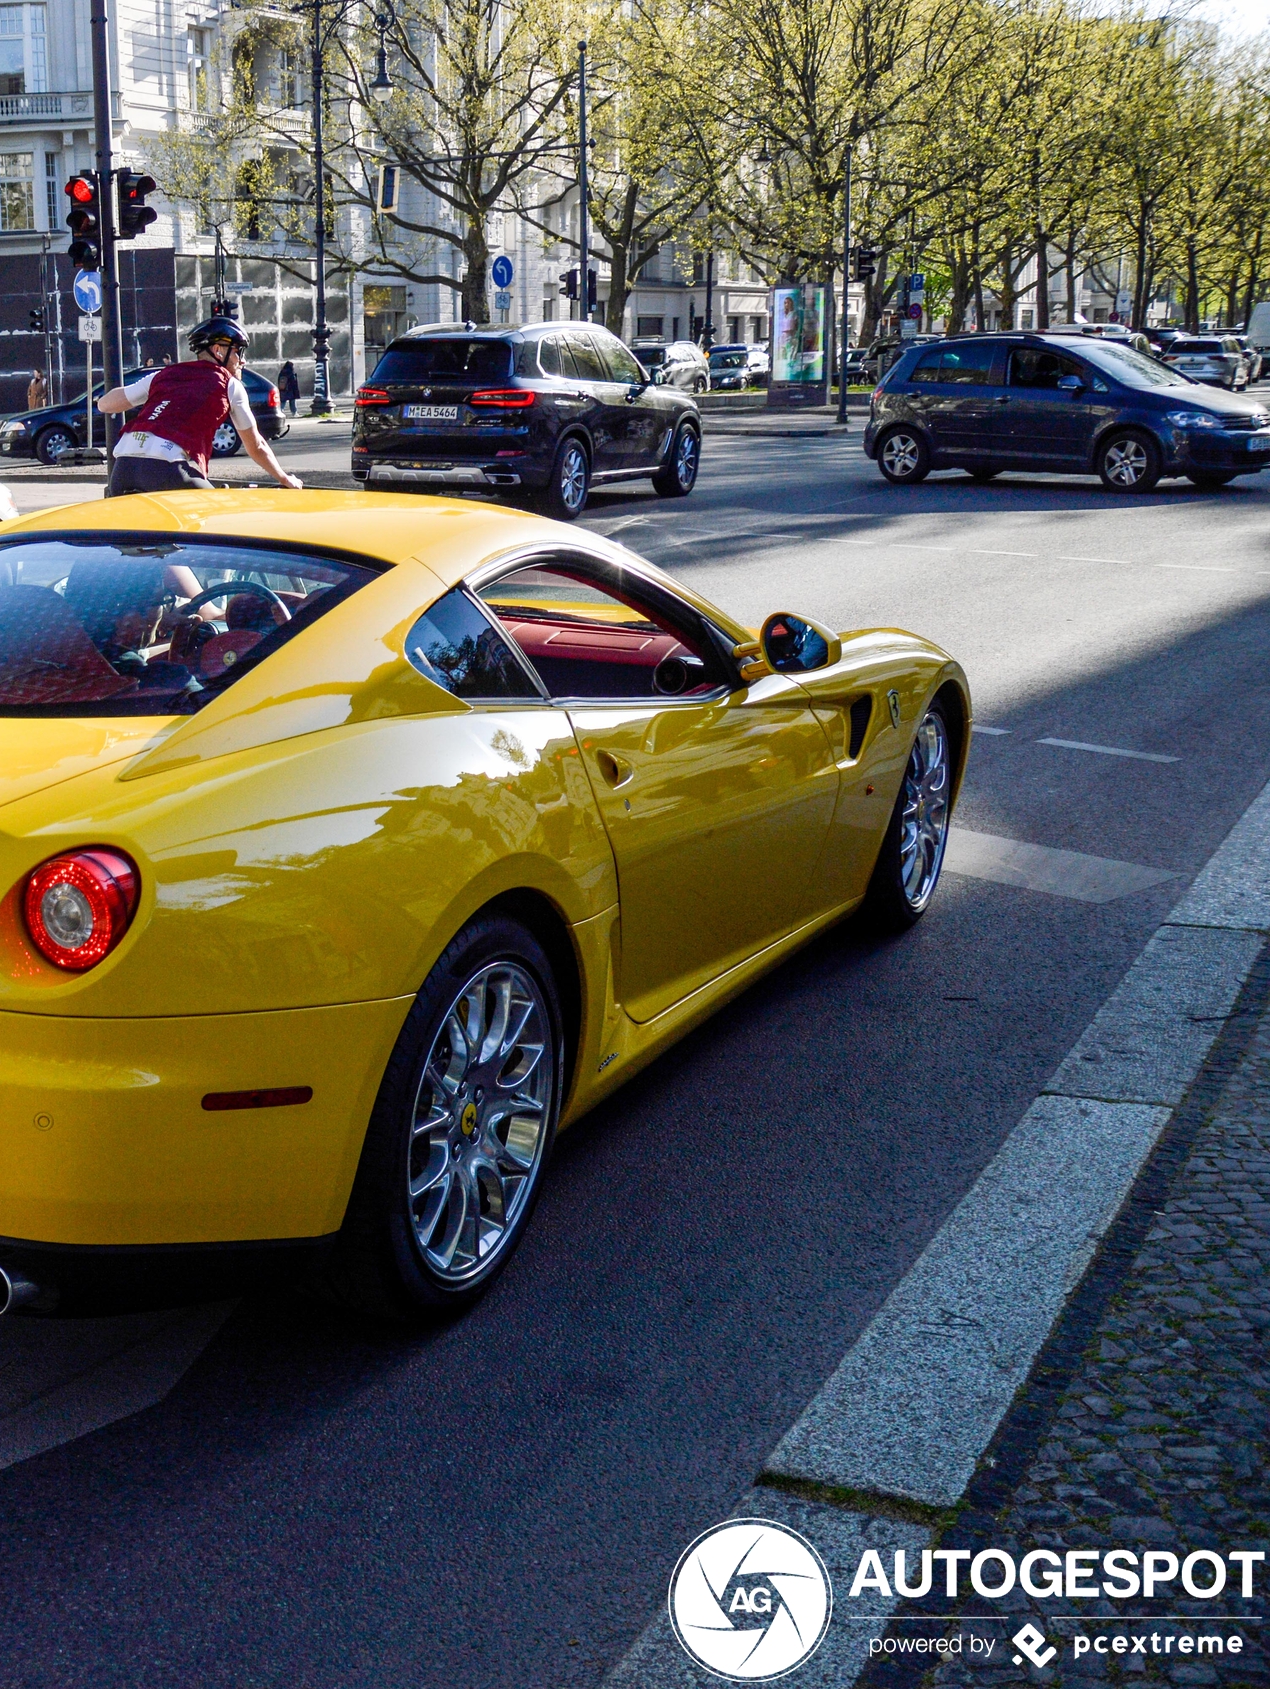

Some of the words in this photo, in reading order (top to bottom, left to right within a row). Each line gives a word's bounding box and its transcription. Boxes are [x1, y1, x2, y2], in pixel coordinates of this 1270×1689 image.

[409, 407, 415, 417] M
[420, 407, 431, 418] EA
[433, 407, 456, 418] 5464
